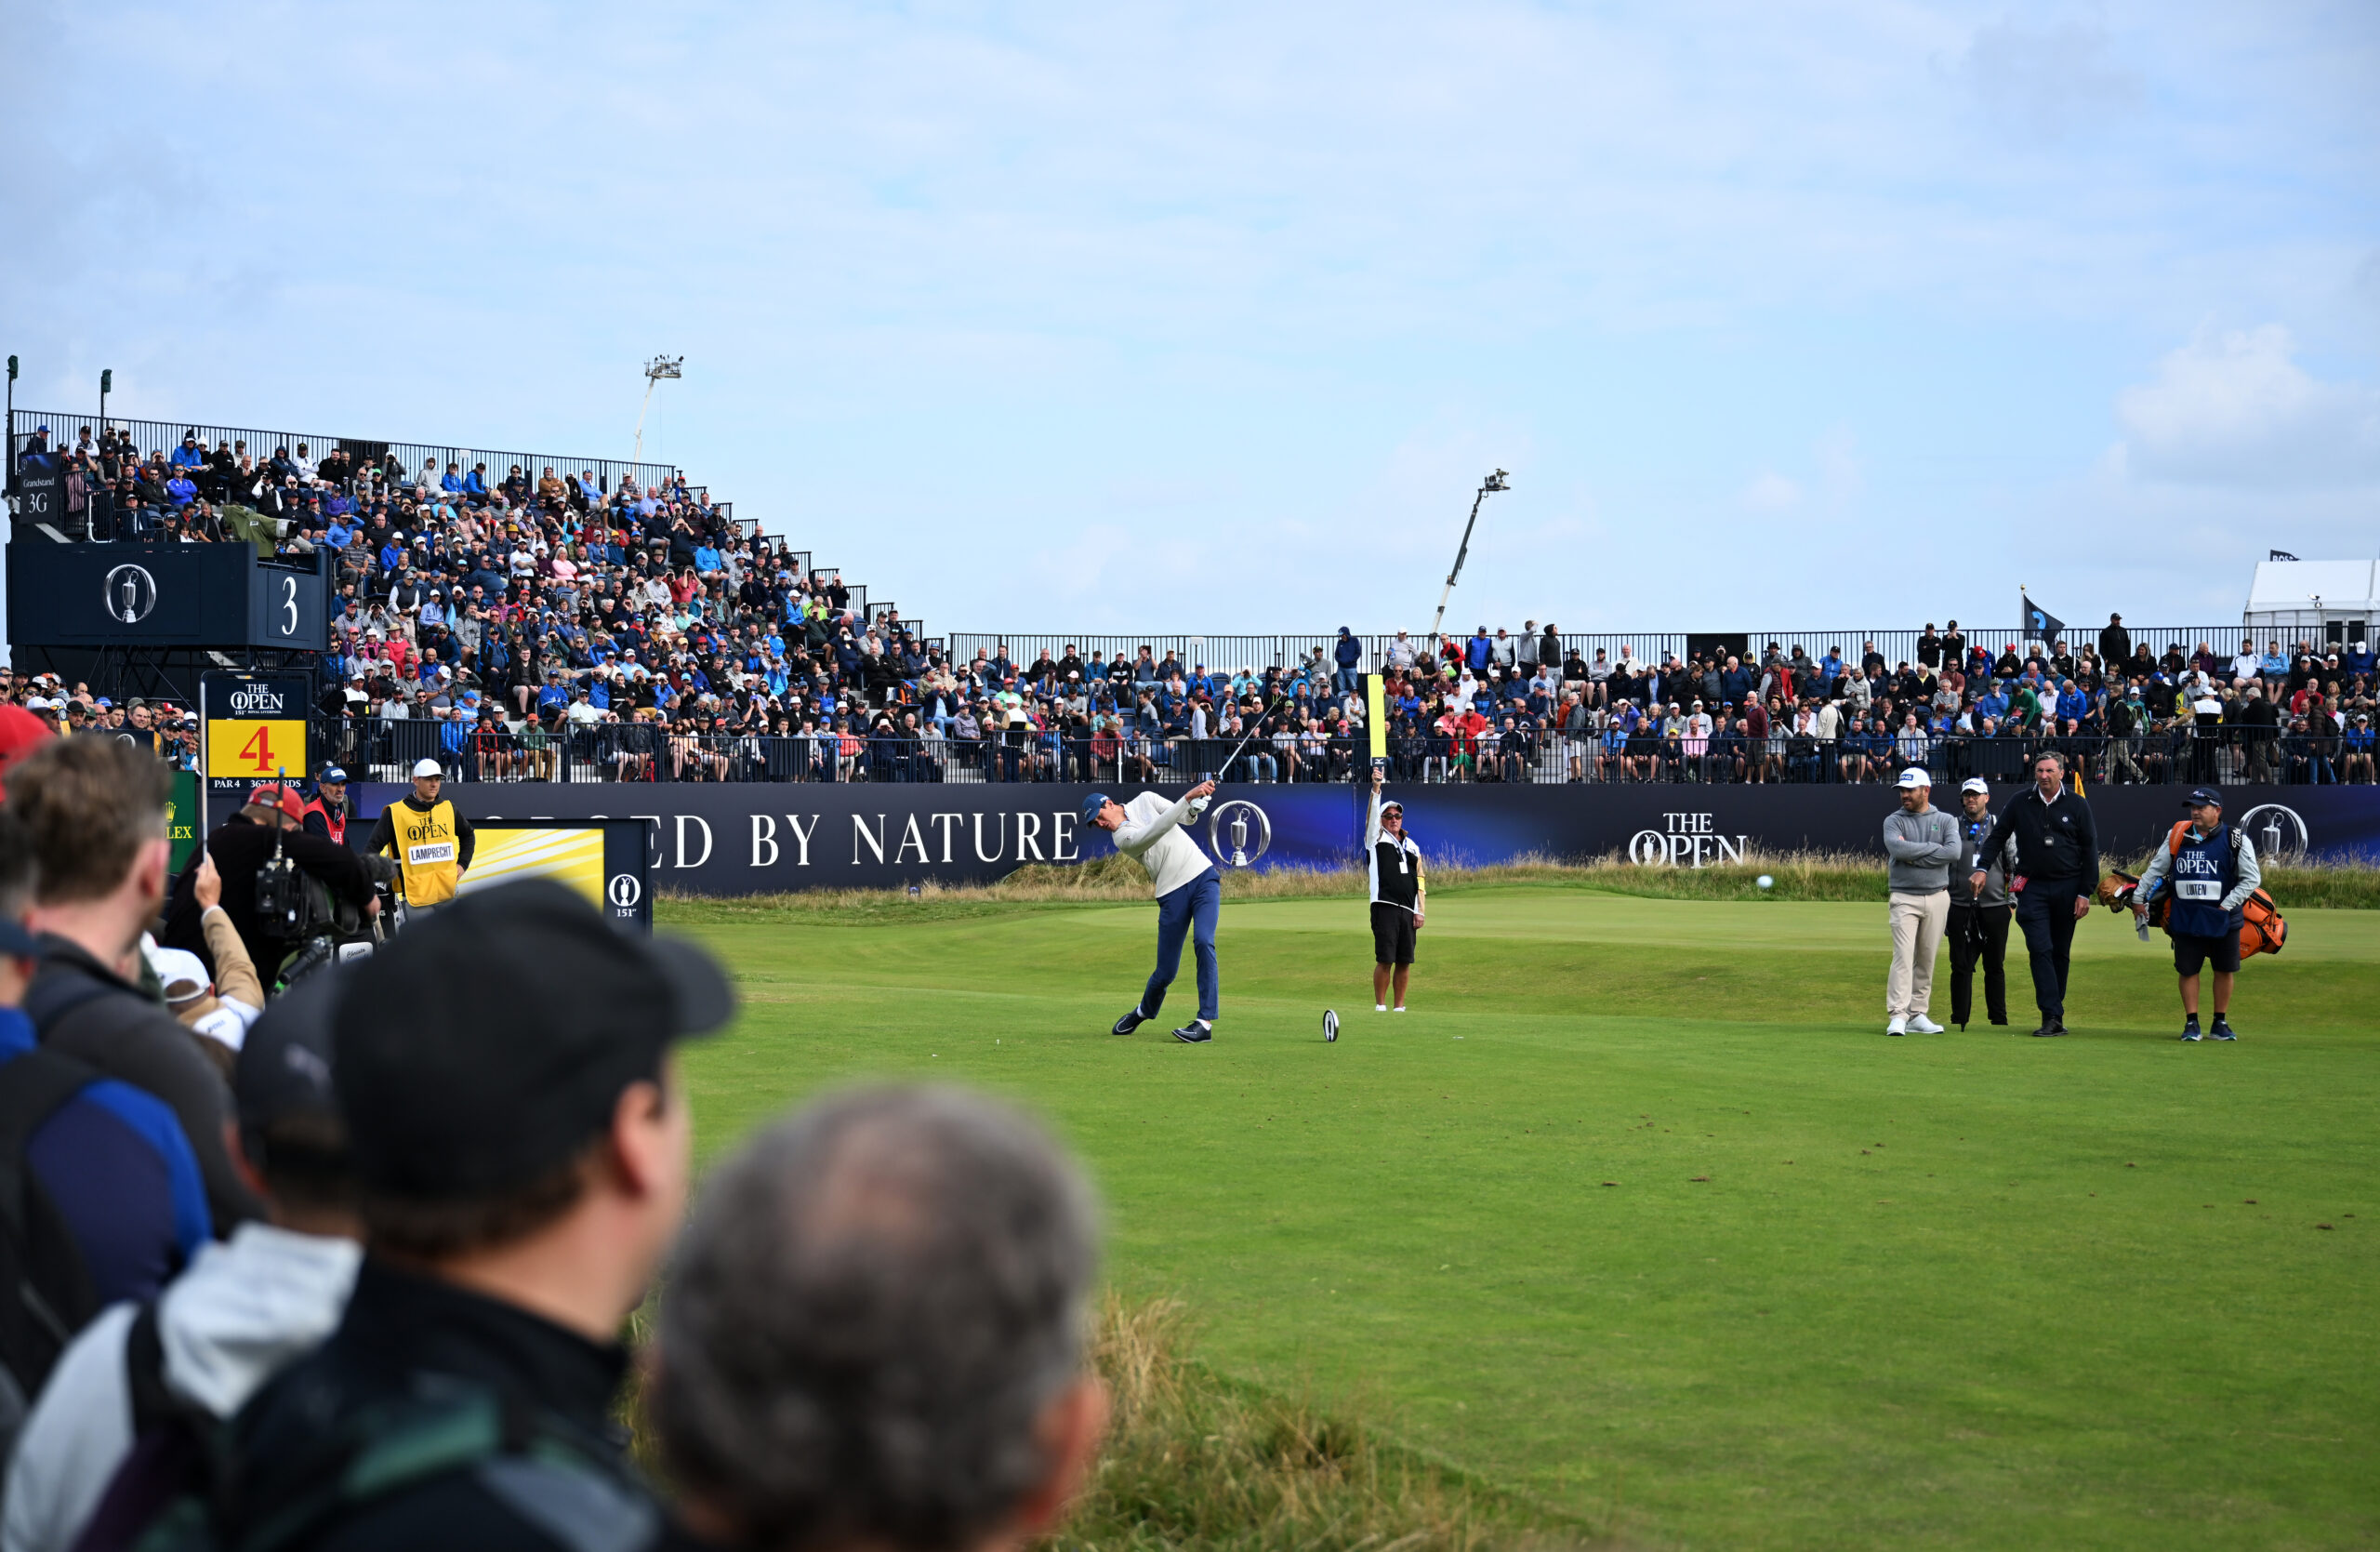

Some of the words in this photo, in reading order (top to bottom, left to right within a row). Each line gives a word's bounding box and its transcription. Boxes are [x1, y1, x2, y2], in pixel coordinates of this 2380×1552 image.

[23, 476, 55, 488] Grandstand
[29, 493, 47, 513] 3G
[282, 577, 298, 635] 3
[245, 683, 269, 694] THE
[230, 691, 284, 710] OPEN
[239, 726, 275, 771] 4
[214, 779, 234, 789] PAR
[234, 779, 241, 788] 4
[250, 779, 267, 789] 367
[407, 823, 448, 841] OPEN
[1663, 813, 1713, 833] THE
[749, 815, 820, 867] BY
[852, 812, 1079, 865] NATURE
[410, 845, 452, 862] LAMPRECHT
[1629, 829, 1748, 869] OPEN
[2185, 850, 2206, 859] THE
[2176, 856, 2218, 874] OPEN
